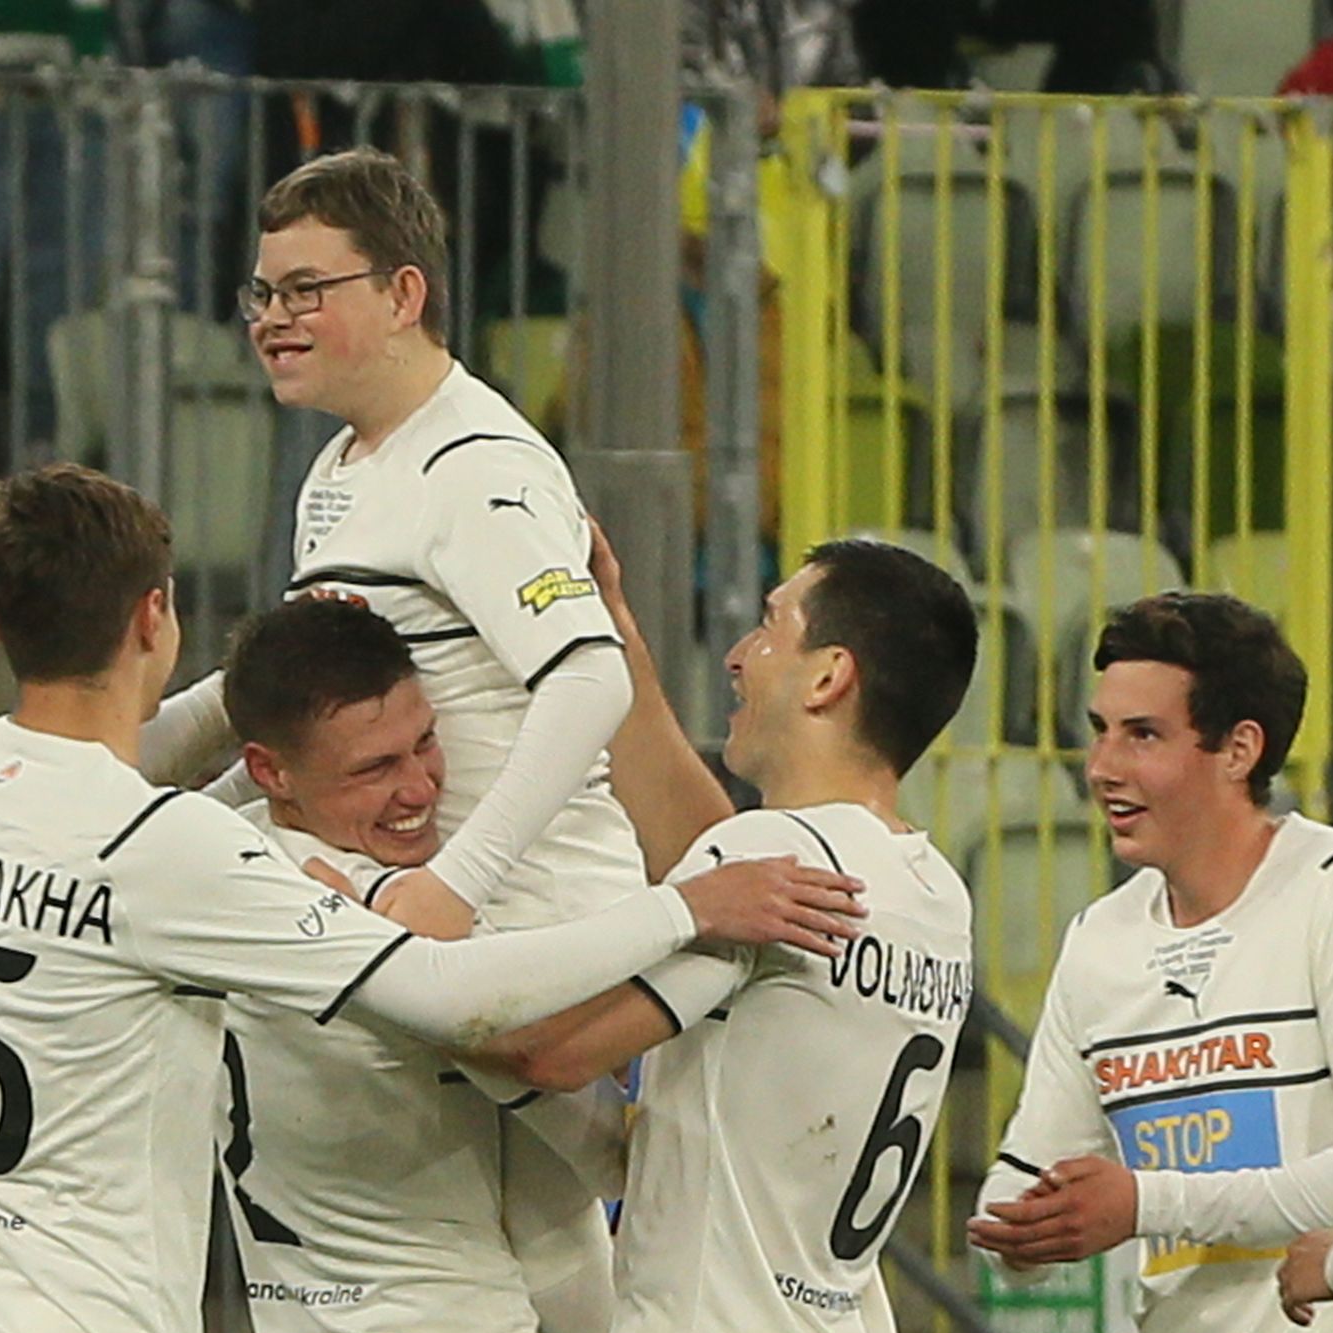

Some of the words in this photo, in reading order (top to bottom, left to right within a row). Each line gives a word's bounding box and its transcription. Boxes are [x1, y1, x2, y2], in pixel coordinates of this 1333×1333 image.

[827, 932, 973, 1021] VOLNOVA
[1094, 1032, 1276, 1095] SHAKHTAR
[829, 1034, 943, 1262] 6
[1134, 1108, 1232, 1170] STOP
